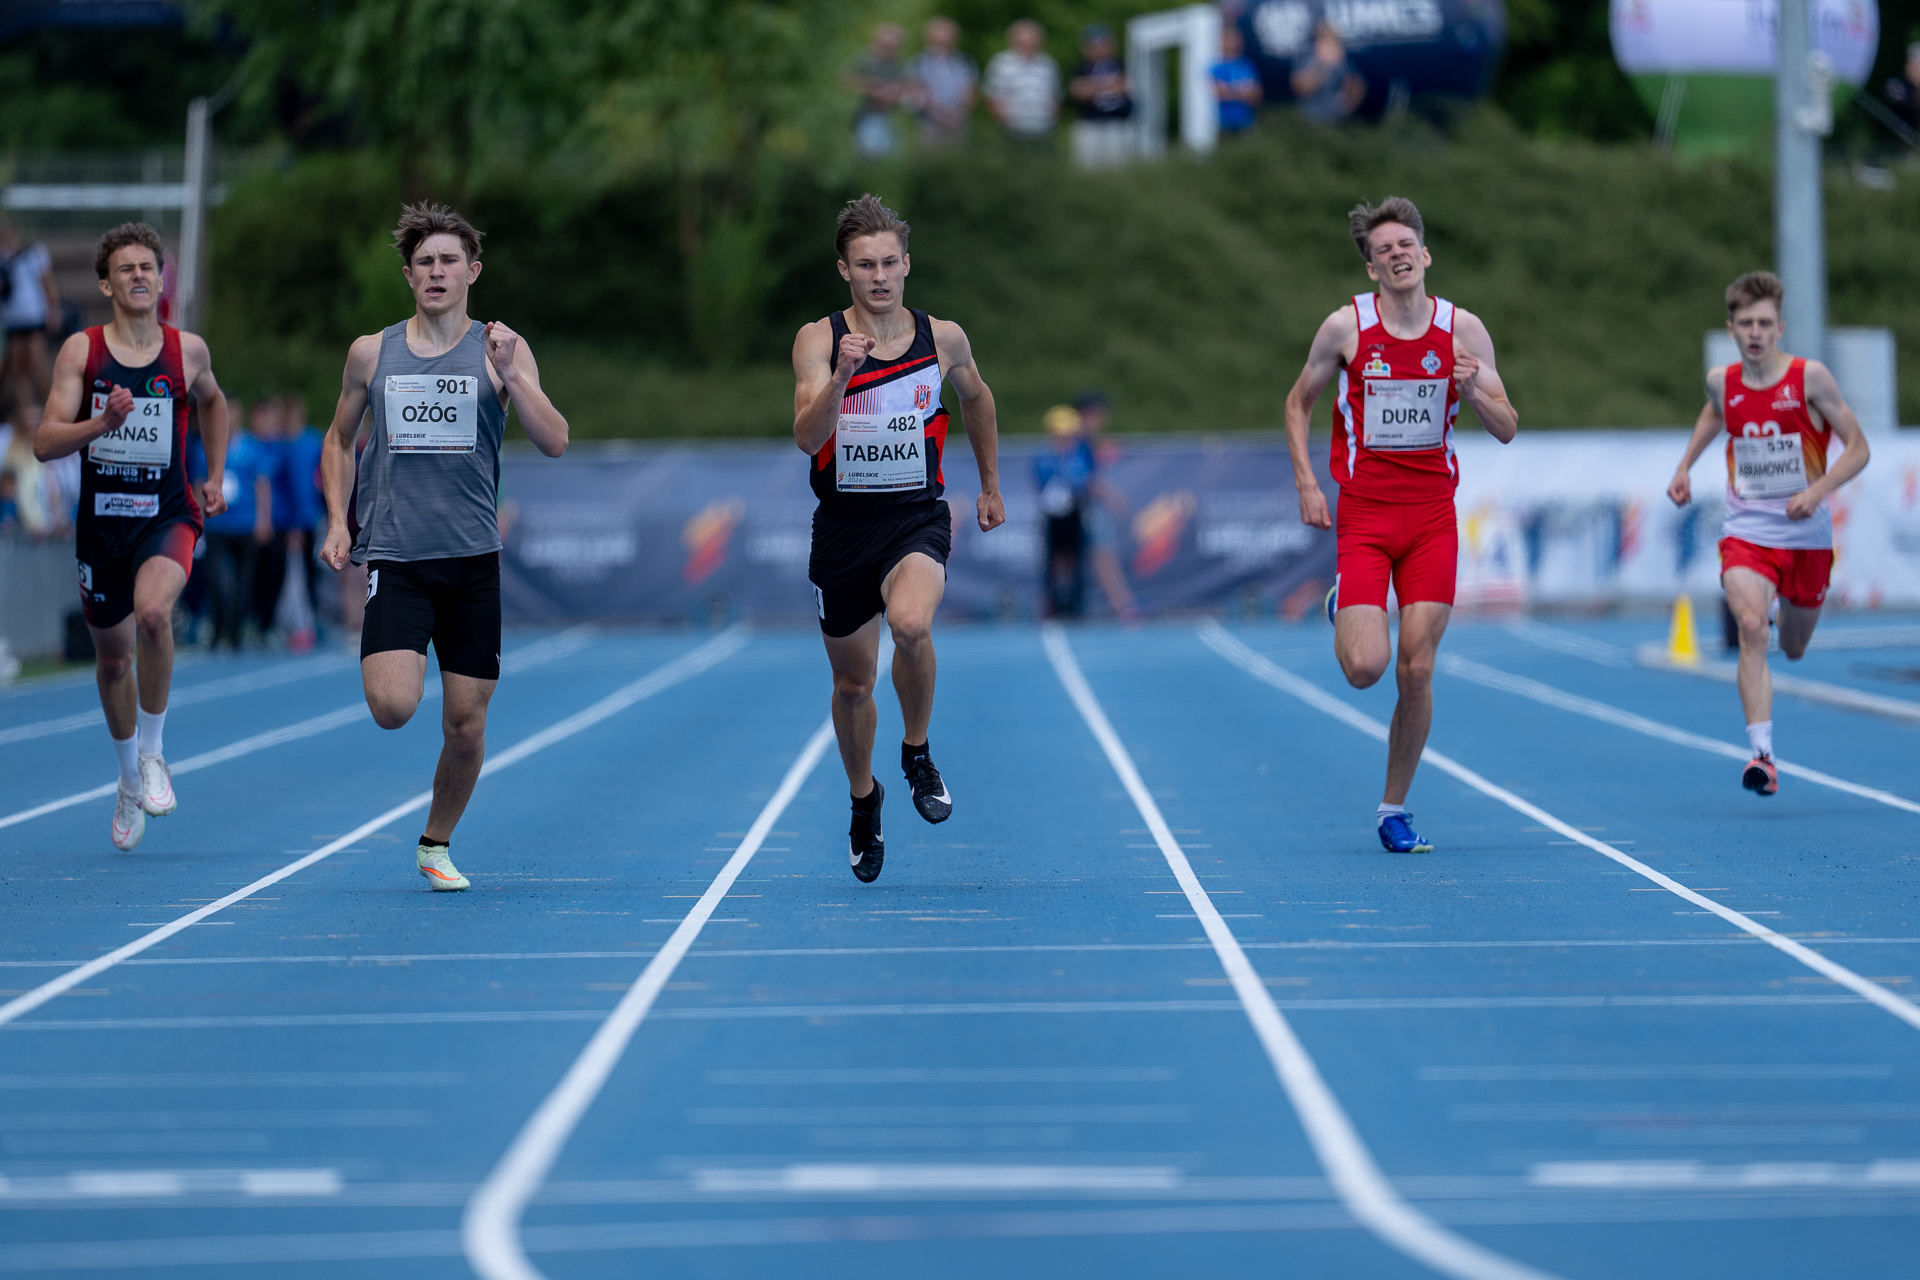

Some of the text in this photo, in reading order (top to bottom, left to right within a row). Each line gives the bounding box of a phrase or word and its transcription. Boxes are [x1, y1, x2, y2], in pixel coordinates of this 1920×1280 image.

[436, 379, 469, 395] 901
[1417, 384, 1437, 398] 87
[143, 403, 161, 417] 61
[402, 400, 458, 423] OŻÓG
[1382, 409, 1431, 424] DURA
[886, 415, 917, 432] 482
[842, 442, 920, 462] TABAKA
[1767, 440, 1794, 452] 539
